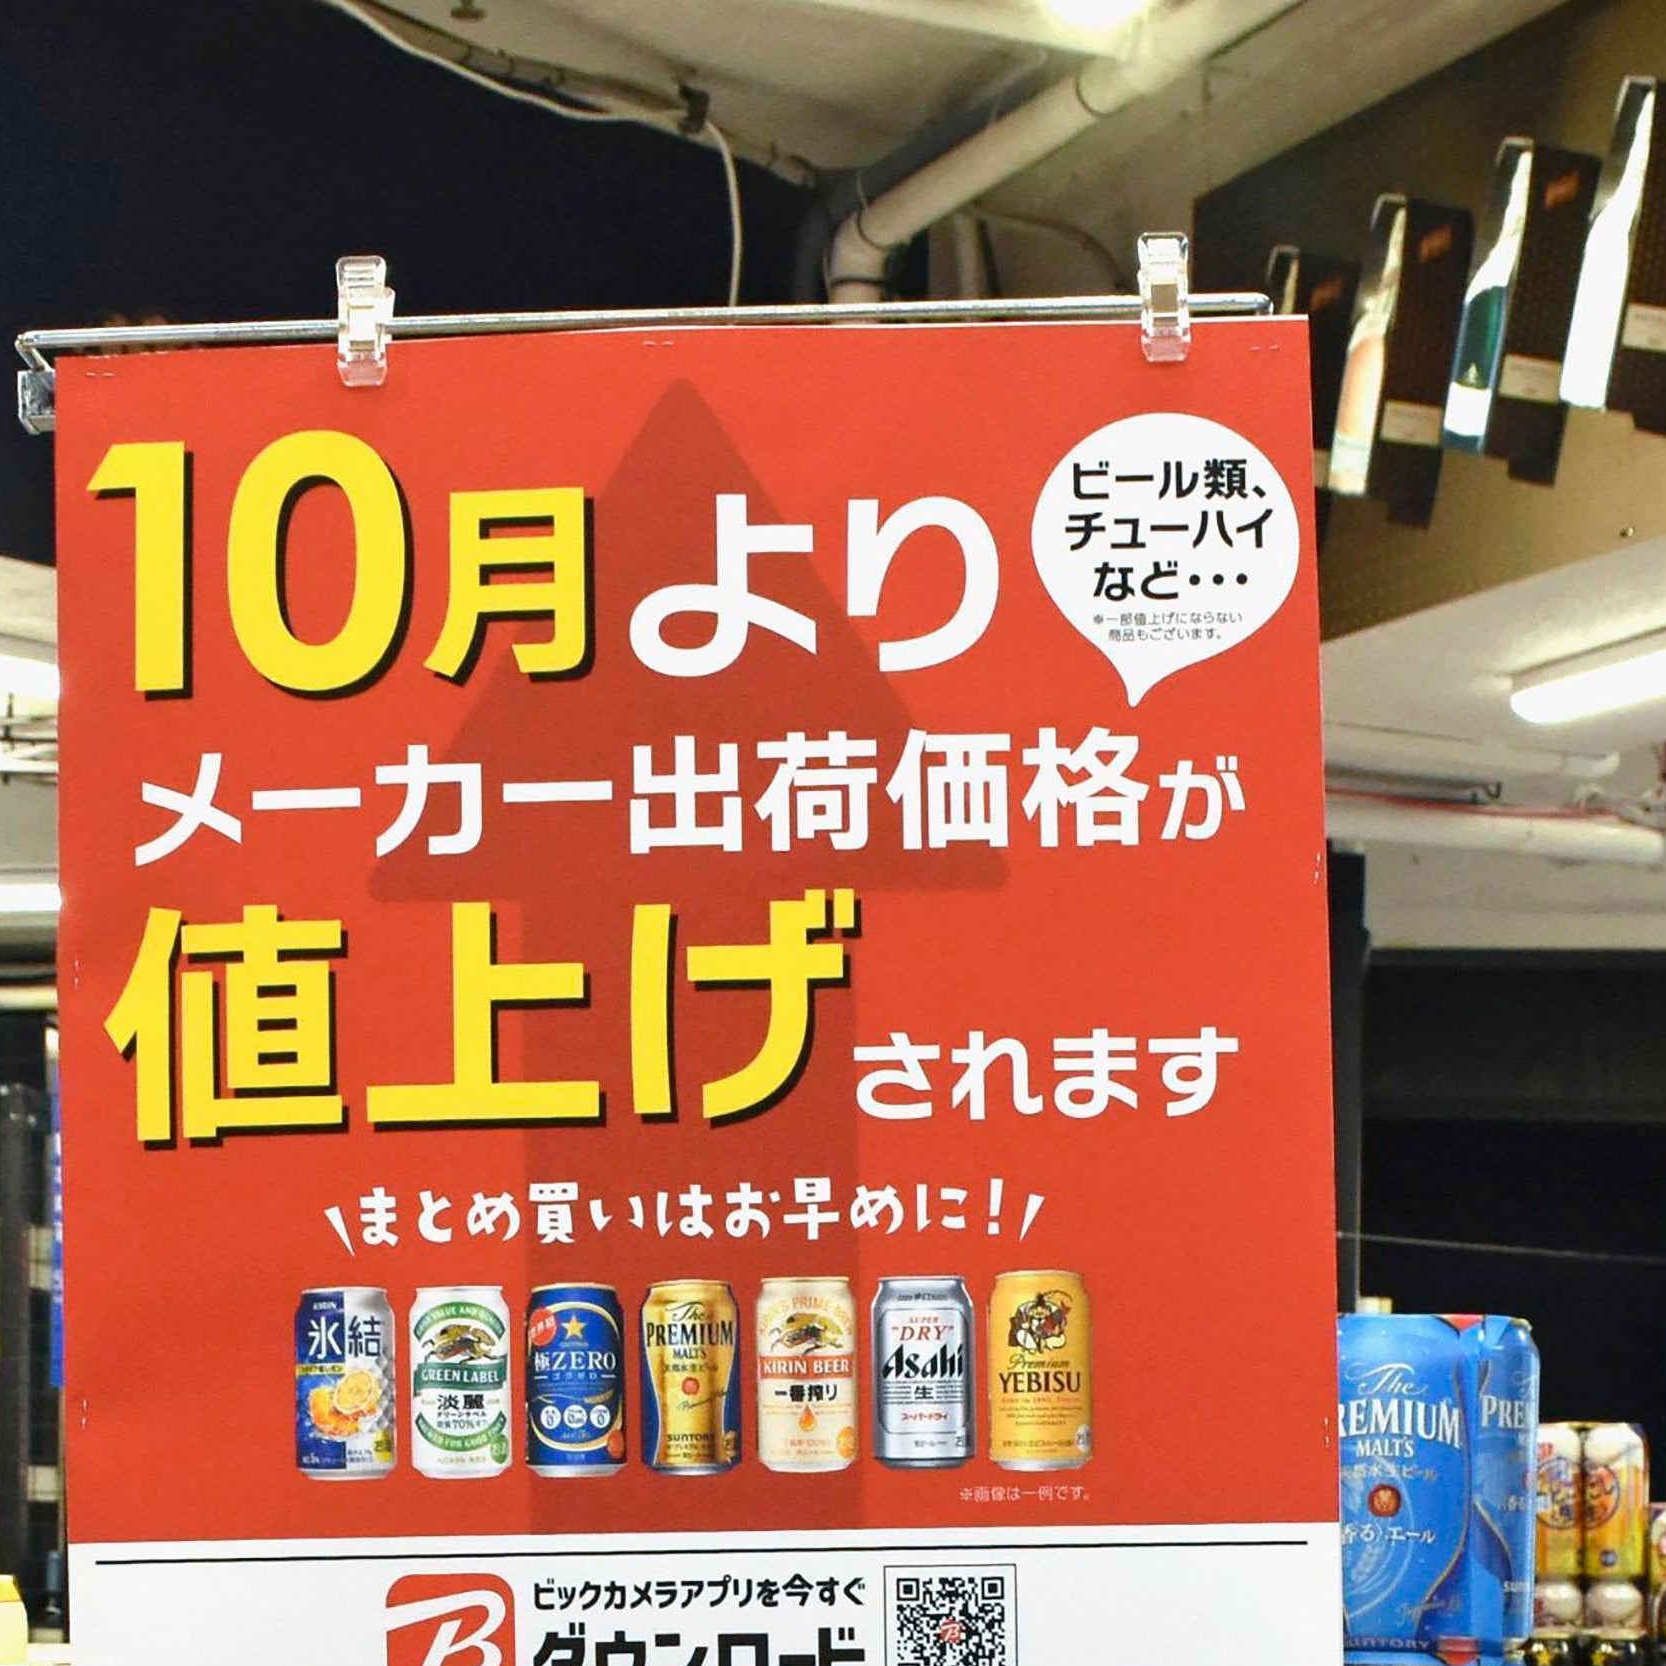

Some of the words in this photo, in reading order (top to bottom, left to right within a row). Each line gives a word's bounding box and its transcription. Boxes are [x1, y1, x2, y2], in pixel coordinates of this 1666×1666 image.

[1073, 458, 1266, 500] ビール類、
[1065, 508, 1273, 551] チューハイ
[87, 429, 1000, 694] 10月より
[1108, 627, 1221, 643] 商品もございます。
[134, 727, 1246, 865] メーカー出荷価格が
[105, 888, 1239, 1142] 値上げされます
[308, 1316, 382, 1359] 氷結
[647, 1319, 733, 1348] PREMIUM
[421, 1368, 460, 1384] GREEN
[463, 1368, 500, 1384] LABEL
[763, 1359, 807, 1374] KIRIN
[813, 1358, 850, 1374] BEER
[882, 1343, 964, 1380] Asahi
[1008, 1356, 1070, 1371] Premium
[999, 1371, 1081, 1394] YEBISU
[1346, 1362, 1428, 1396] The
[437, 1394, 485, 1411] 淡麗
[959, 1486, 1090, 1503] ※画像は一例です。
[532, 1574, 865, 1615] ビックカメラアプリを今すぐ
